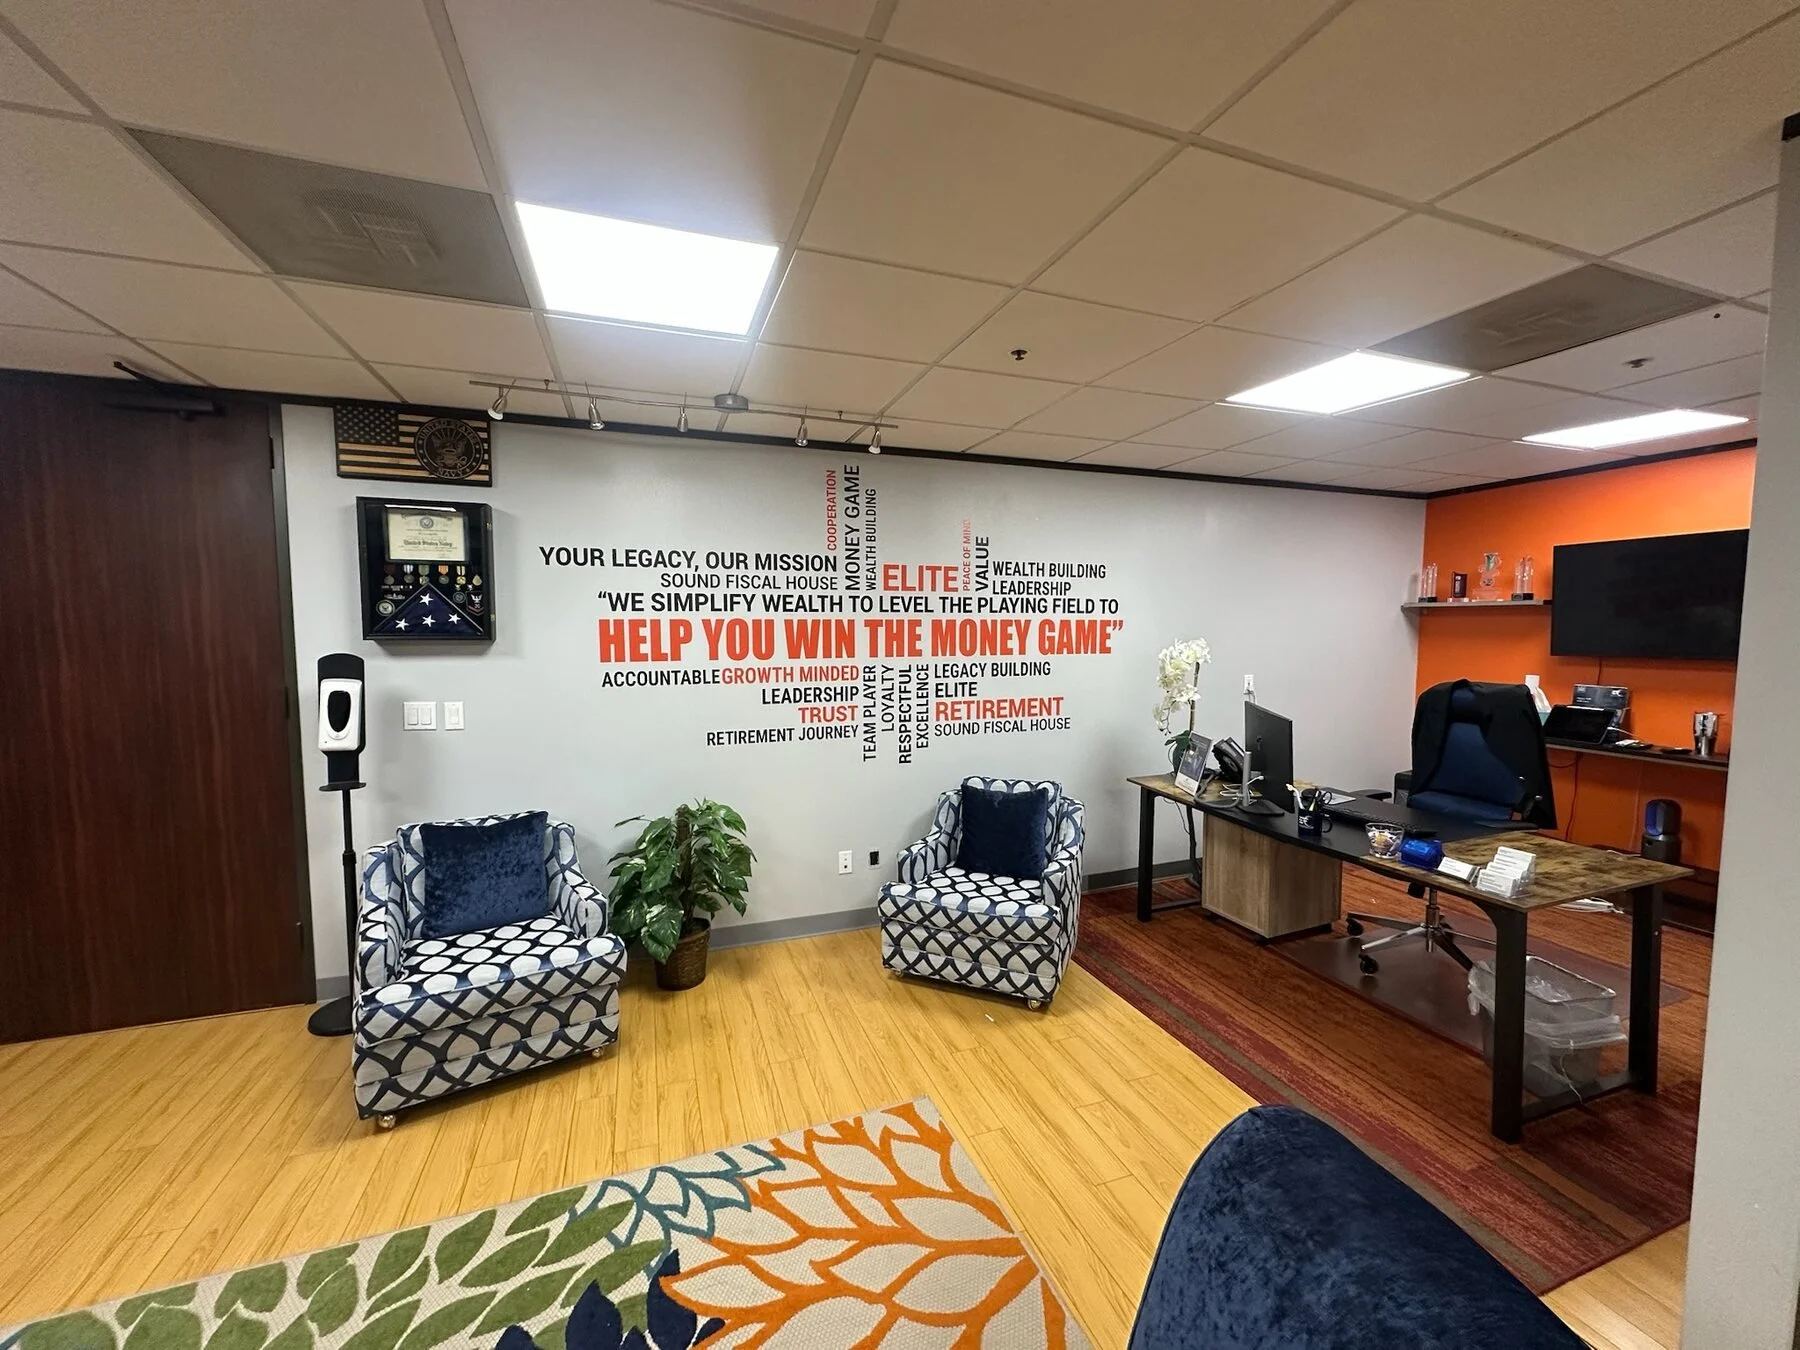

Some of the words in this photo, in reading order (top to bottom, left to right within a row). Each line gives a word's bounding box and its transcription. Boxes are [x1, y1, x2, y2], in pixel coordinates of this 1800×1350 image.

[844, 465, 859, 518] GAME
[827, 470, 837, 550] COOPERATION
[866, 488, 876, 543] BUILDING
[540, 547, 604, 566] YOUR
[612, 548, 699, 572] LEGACY,
[705, 552, 748, 570] OUR
[755, 553, 837, 572] MISSION
[845, 524, 860, 590] MONEY
[963, 546, 971, 560] OF
[976, 536, 989, 591] VALUE
[661, 573, 720, 589] SOUND
[726, 574, 781, 589] FISCAL
[786, 575, 838, 590] HOUSE
[866, 547, 876, 591] WEALTH
[883, 564, 959, 592] ELITE
[963, 562, 971, 591] PEACE
[993, 561, 1045, 578] WEALTH
[1049, 563, 1106, 579] BUILDING
[993, 580, 1071, 596] LEADERSHIP
[598, 591, 644, 612] “WE
[651, 593, 756, 612] SIMPLIFY
[763, 595, 843, 613] WEALTH
[849, 596, 873, 613] TO
[880, 596, 934, 613] LEVEL
[939, 597, 973, 613] THE
[977, 597, 1048, 614] PLAYING
[1052, 598, 1095, 614] FIELD
[1100, 599, 1118, 614] TO
[599, 618, 692, 663] HELP
[702, 618, 774, 661] YOU
[784, 619, 855, 659] WIN
[864, 619, 922, 658] THE
[931, 619, 1031, 657] MONEY
[1038, 619, 1124, 656] GAME”
[602, 669, 720, 688] ACCOUNTABLE
[722, 667, 794, 684] GROWTH
[800, 665, 859, 682] MINDED
[935, 663, 986, 679] LEGACY
[991, 662, 1050, 677] BUILDING
[762, 686, 859, 705] LEADERSHIP
[863, 665, 876, 718] PLAYER
[881, 664, 894, 732] LOYALTY
[935, 682, 977, 698] ELITE
[798, 705, 858, 724] TRUST
[899, 665, 911, 764] RESPECTFUL
[917, 664, 929, 748] EXCELLENCE
[935, 697, 1064, 721] RETIREMENT
[707, 728, 795, 746] RETIREMENT
[799, 725, 858, 741] JOURNEY
[935, 721, 980, 736] SOUND
[984, 719, 1027, 734] FISCAL
[1030, 718, 1070, 732] HOUSE
[863, 722, 876, 762] TEAM
